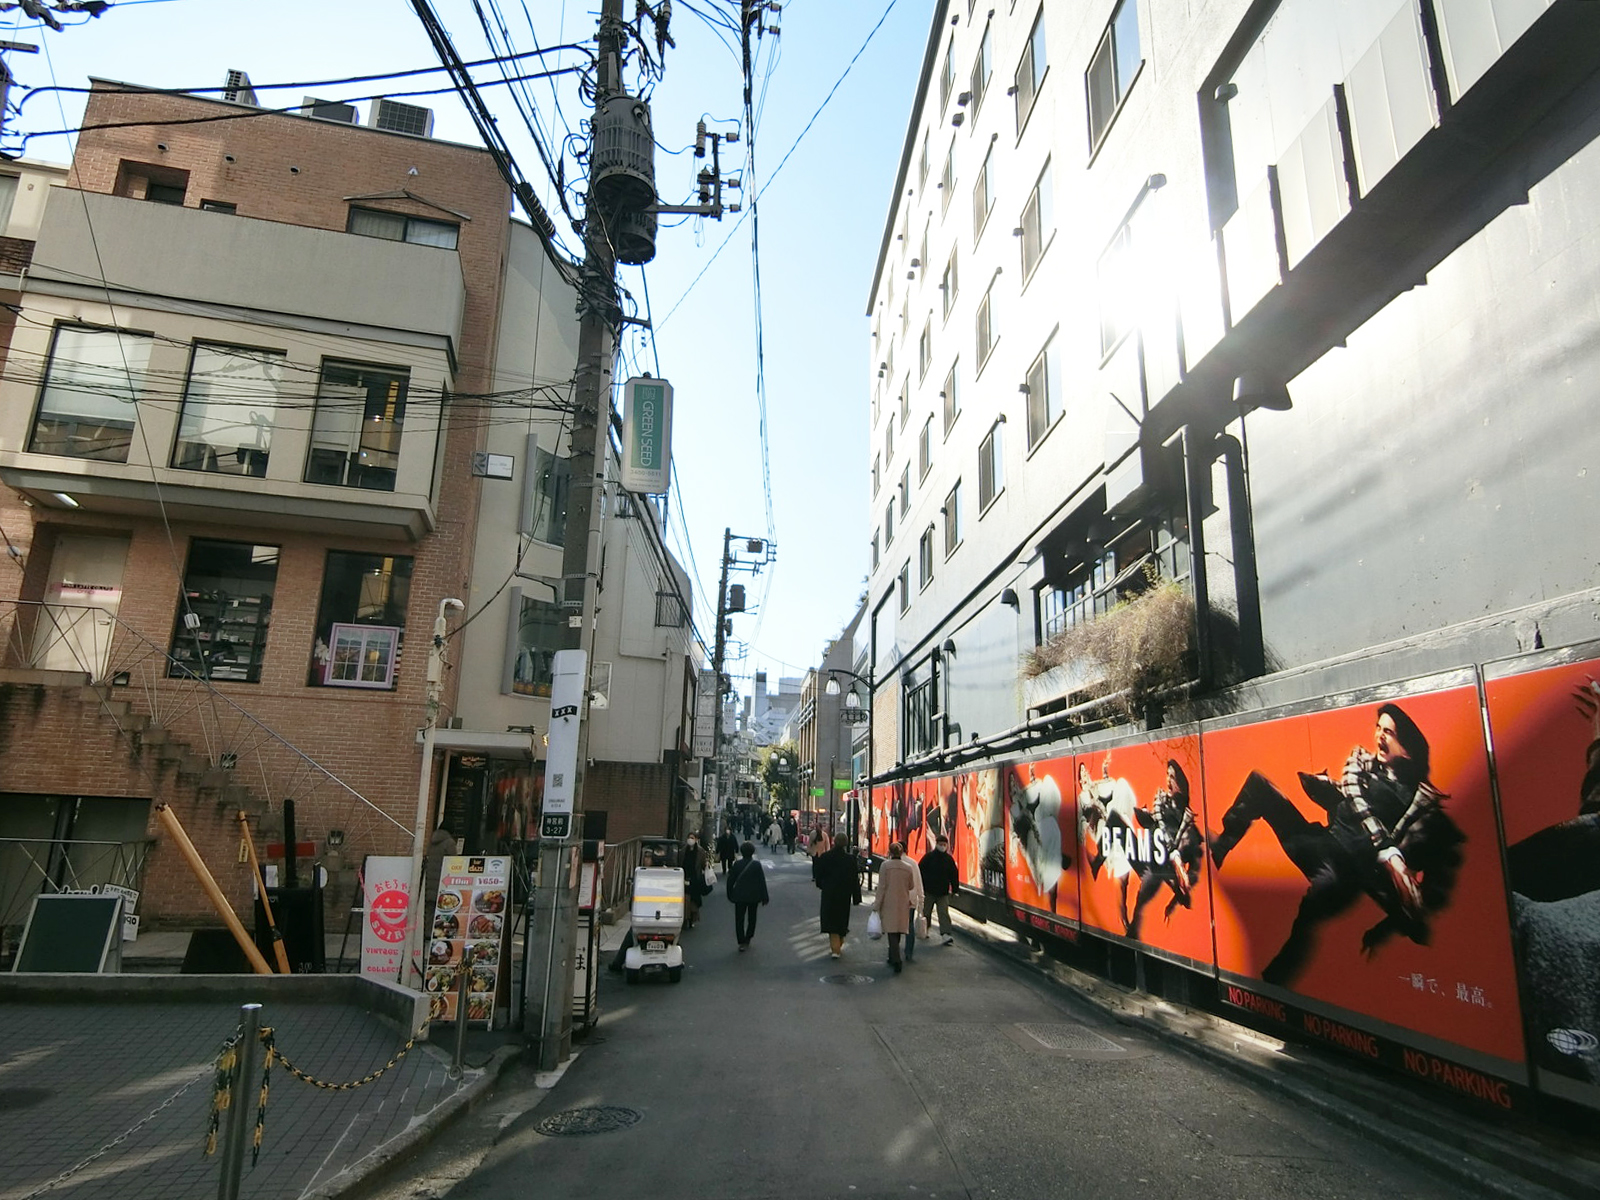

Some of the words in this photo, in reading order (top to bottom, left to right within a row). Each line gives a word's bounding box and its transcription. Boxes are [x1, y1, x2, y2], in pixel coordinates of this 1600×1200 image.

[641, 401, 654, 437] GREEN
[640, 439, 653, 467] SEED
[546, 826, 563, 834] 3-27
[1101, 826, 1166, 865] BEAMS
[372, 920, 404, 940] SPIR
[1228, 986, 1243, 1005] NO
[1244, 991, 1286, 1022] PARKING
[1303, 1013, 1321, 1035] NO
[1323, 1022, 1379, 1058] PARKING
[1403, 1048, 1428, 1076] NO
[1431, 1060, 1512, 1109] PARKING
